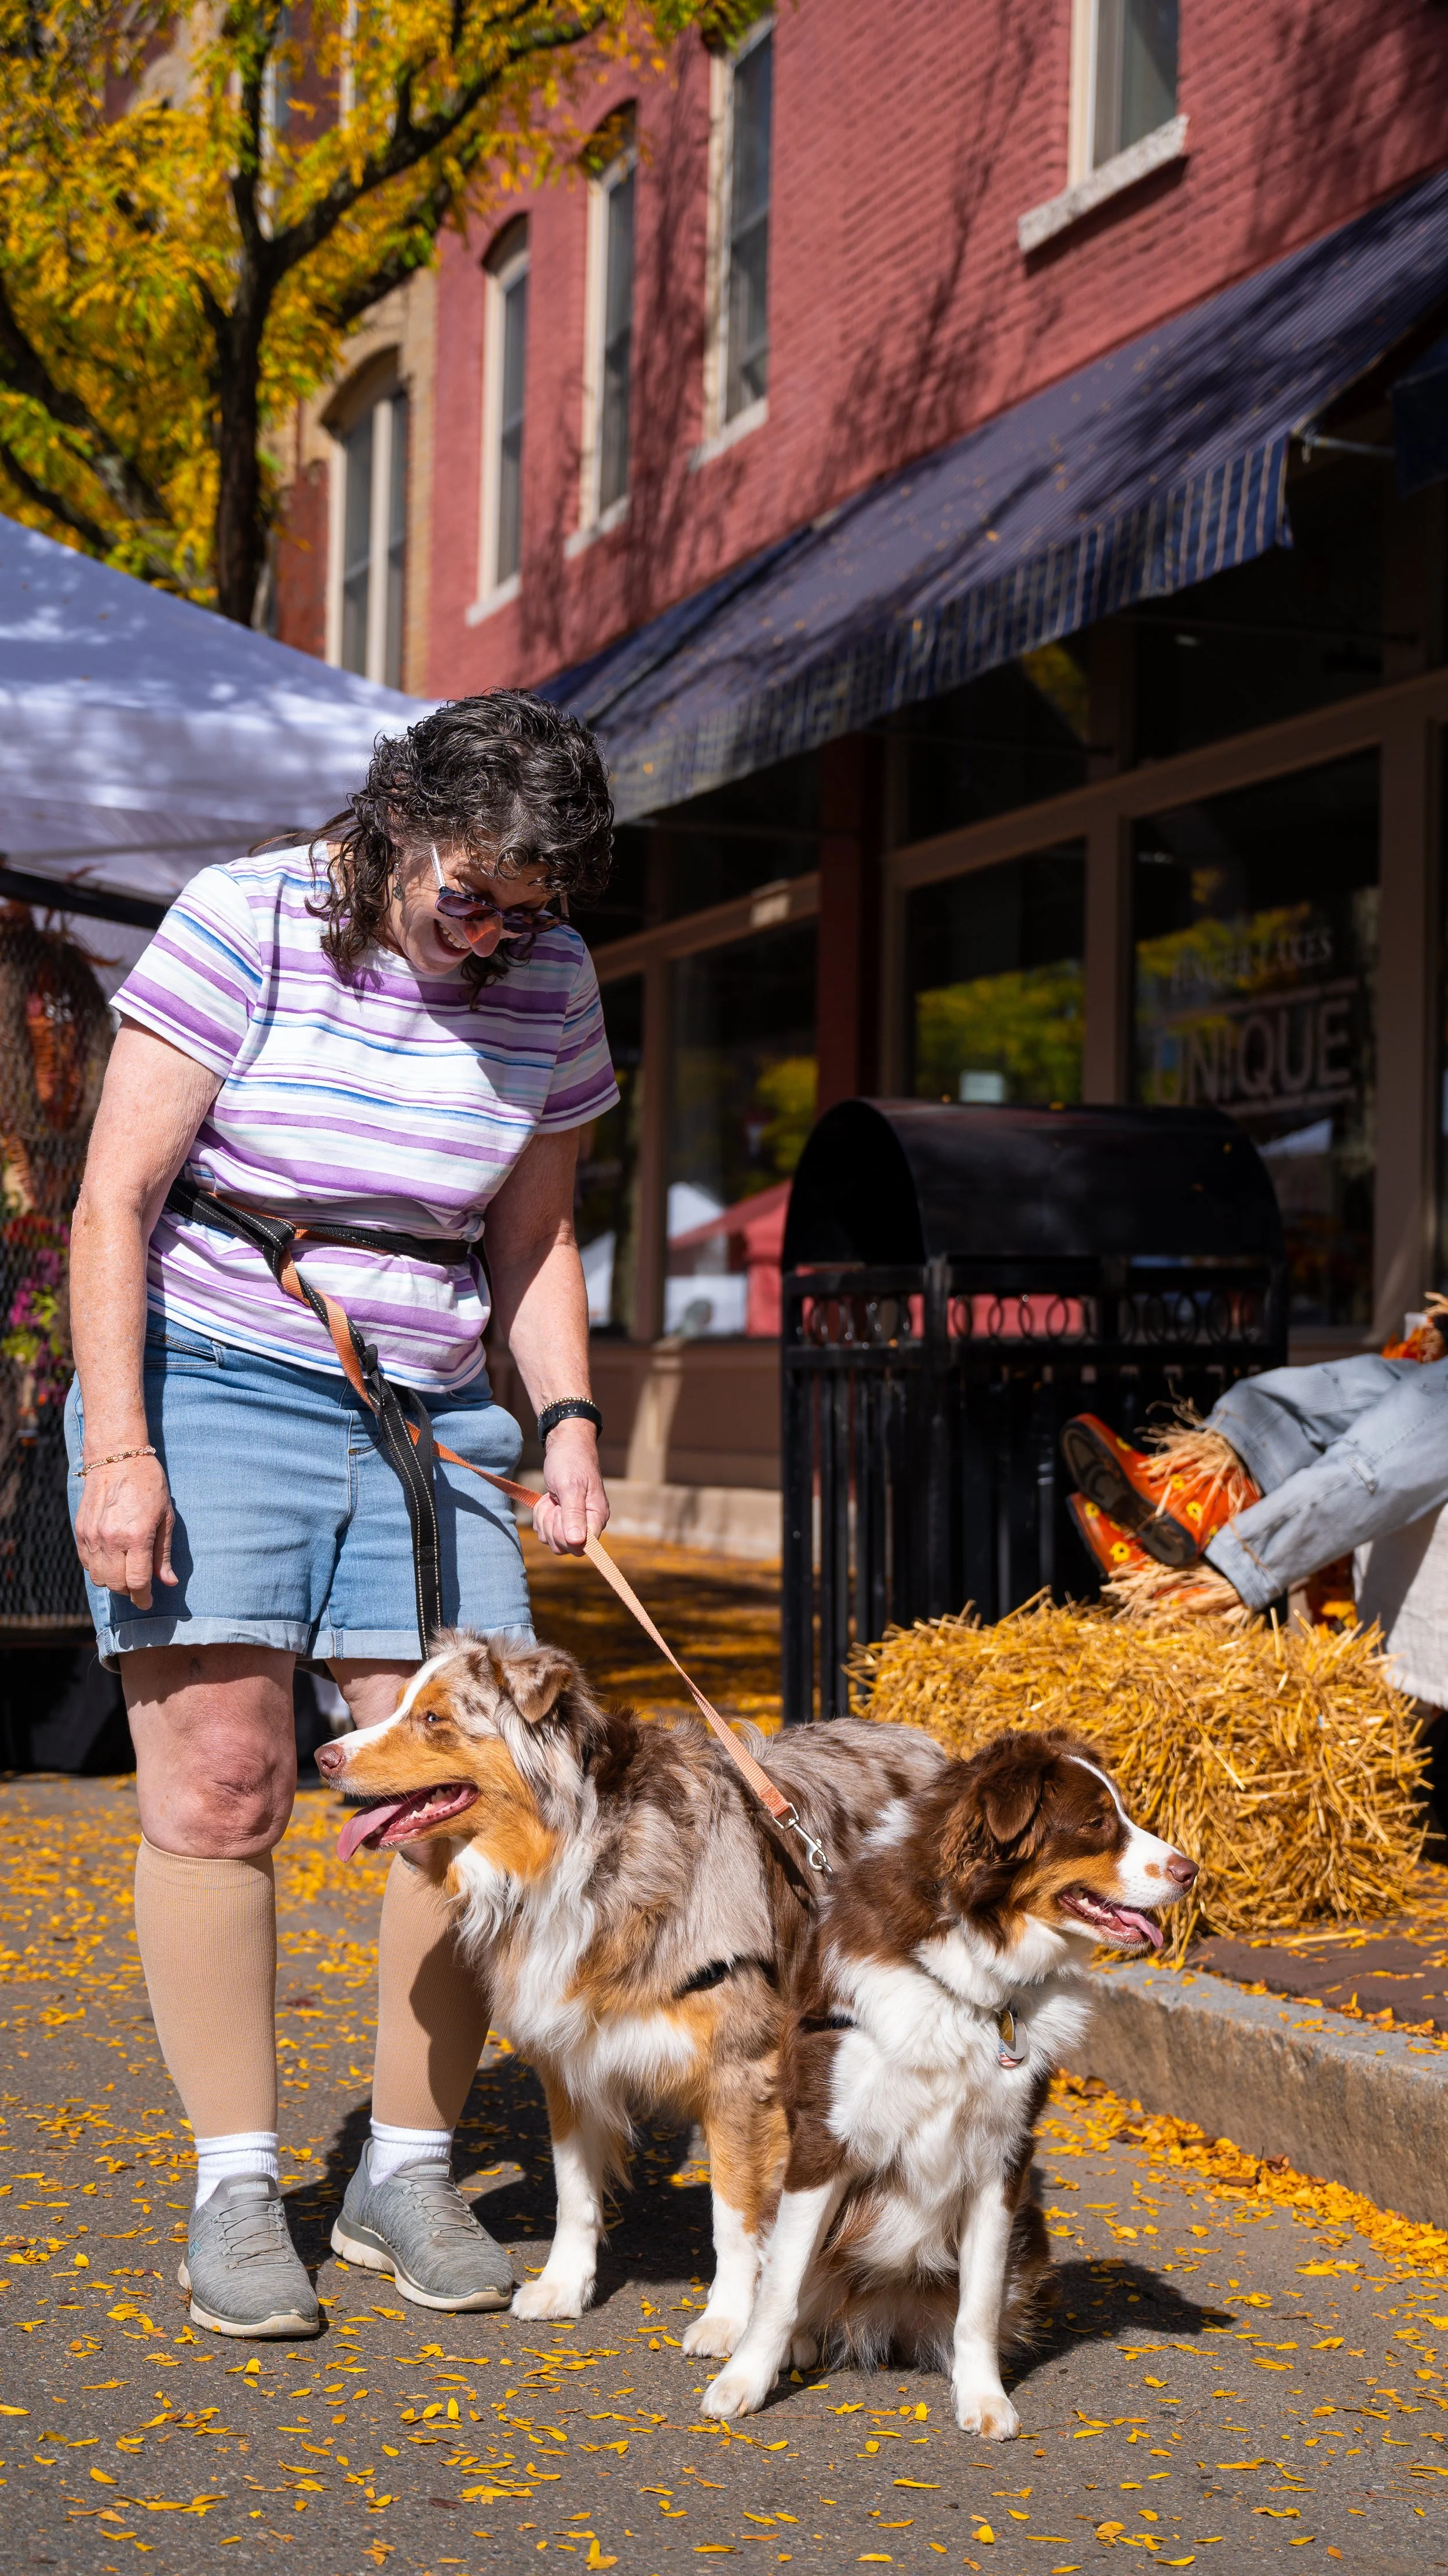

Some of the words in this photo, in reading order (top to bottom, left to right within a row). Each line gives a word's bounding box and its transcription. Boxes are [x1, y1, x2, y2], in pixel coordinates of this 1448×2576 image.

[1160, 945, 1254, 996] INGER
[1259, 926, 1333, 976] LAKES
[1154, 999, 1351, 1104] UNIQUE
